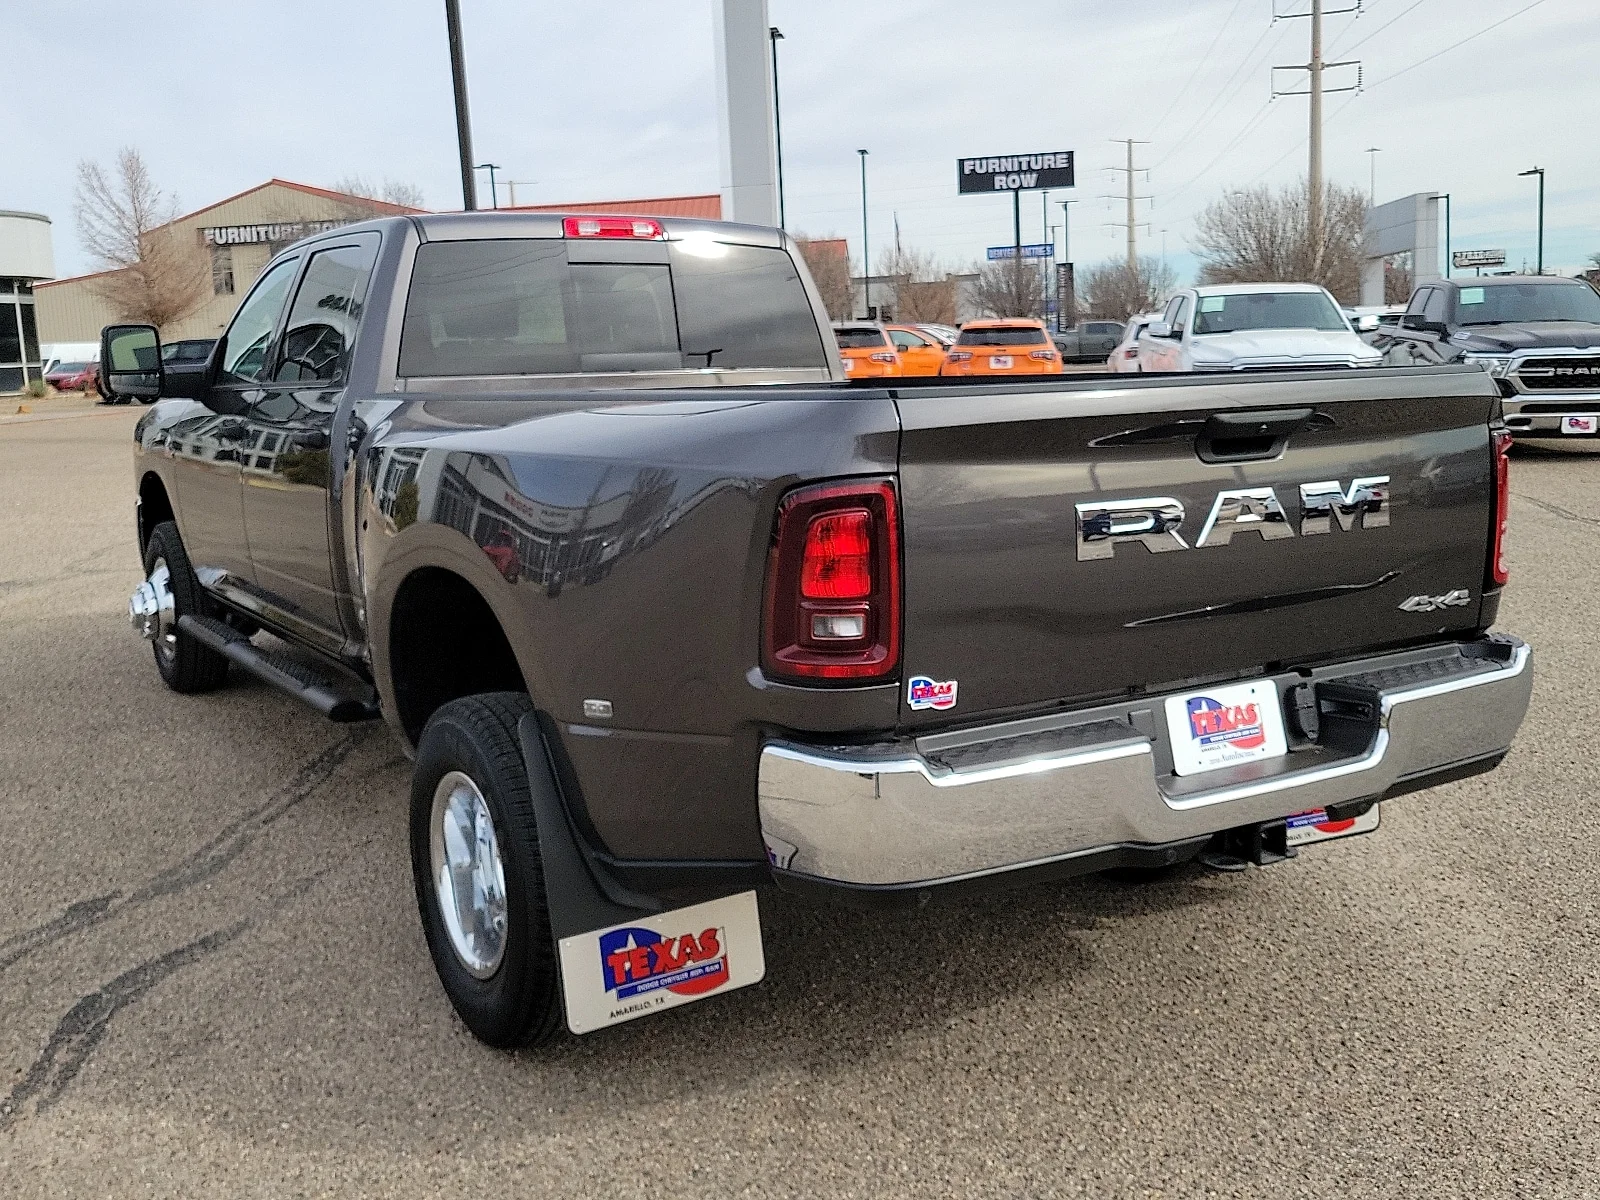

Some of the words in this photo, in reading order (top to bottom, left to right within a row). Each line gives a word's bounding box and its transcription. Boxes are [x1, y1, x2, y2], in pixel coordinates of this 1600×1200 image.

[963, 153, 1069, 175] FURNITURE
[994, 173, 1039, 190] ROW
[1075, 475, 1391, 562] RAM
[912, 683, 952, 699] TEXAS
[1192, 704, 1258, 735] TEXAS
[607, 928, 720, 984] TEXAS
